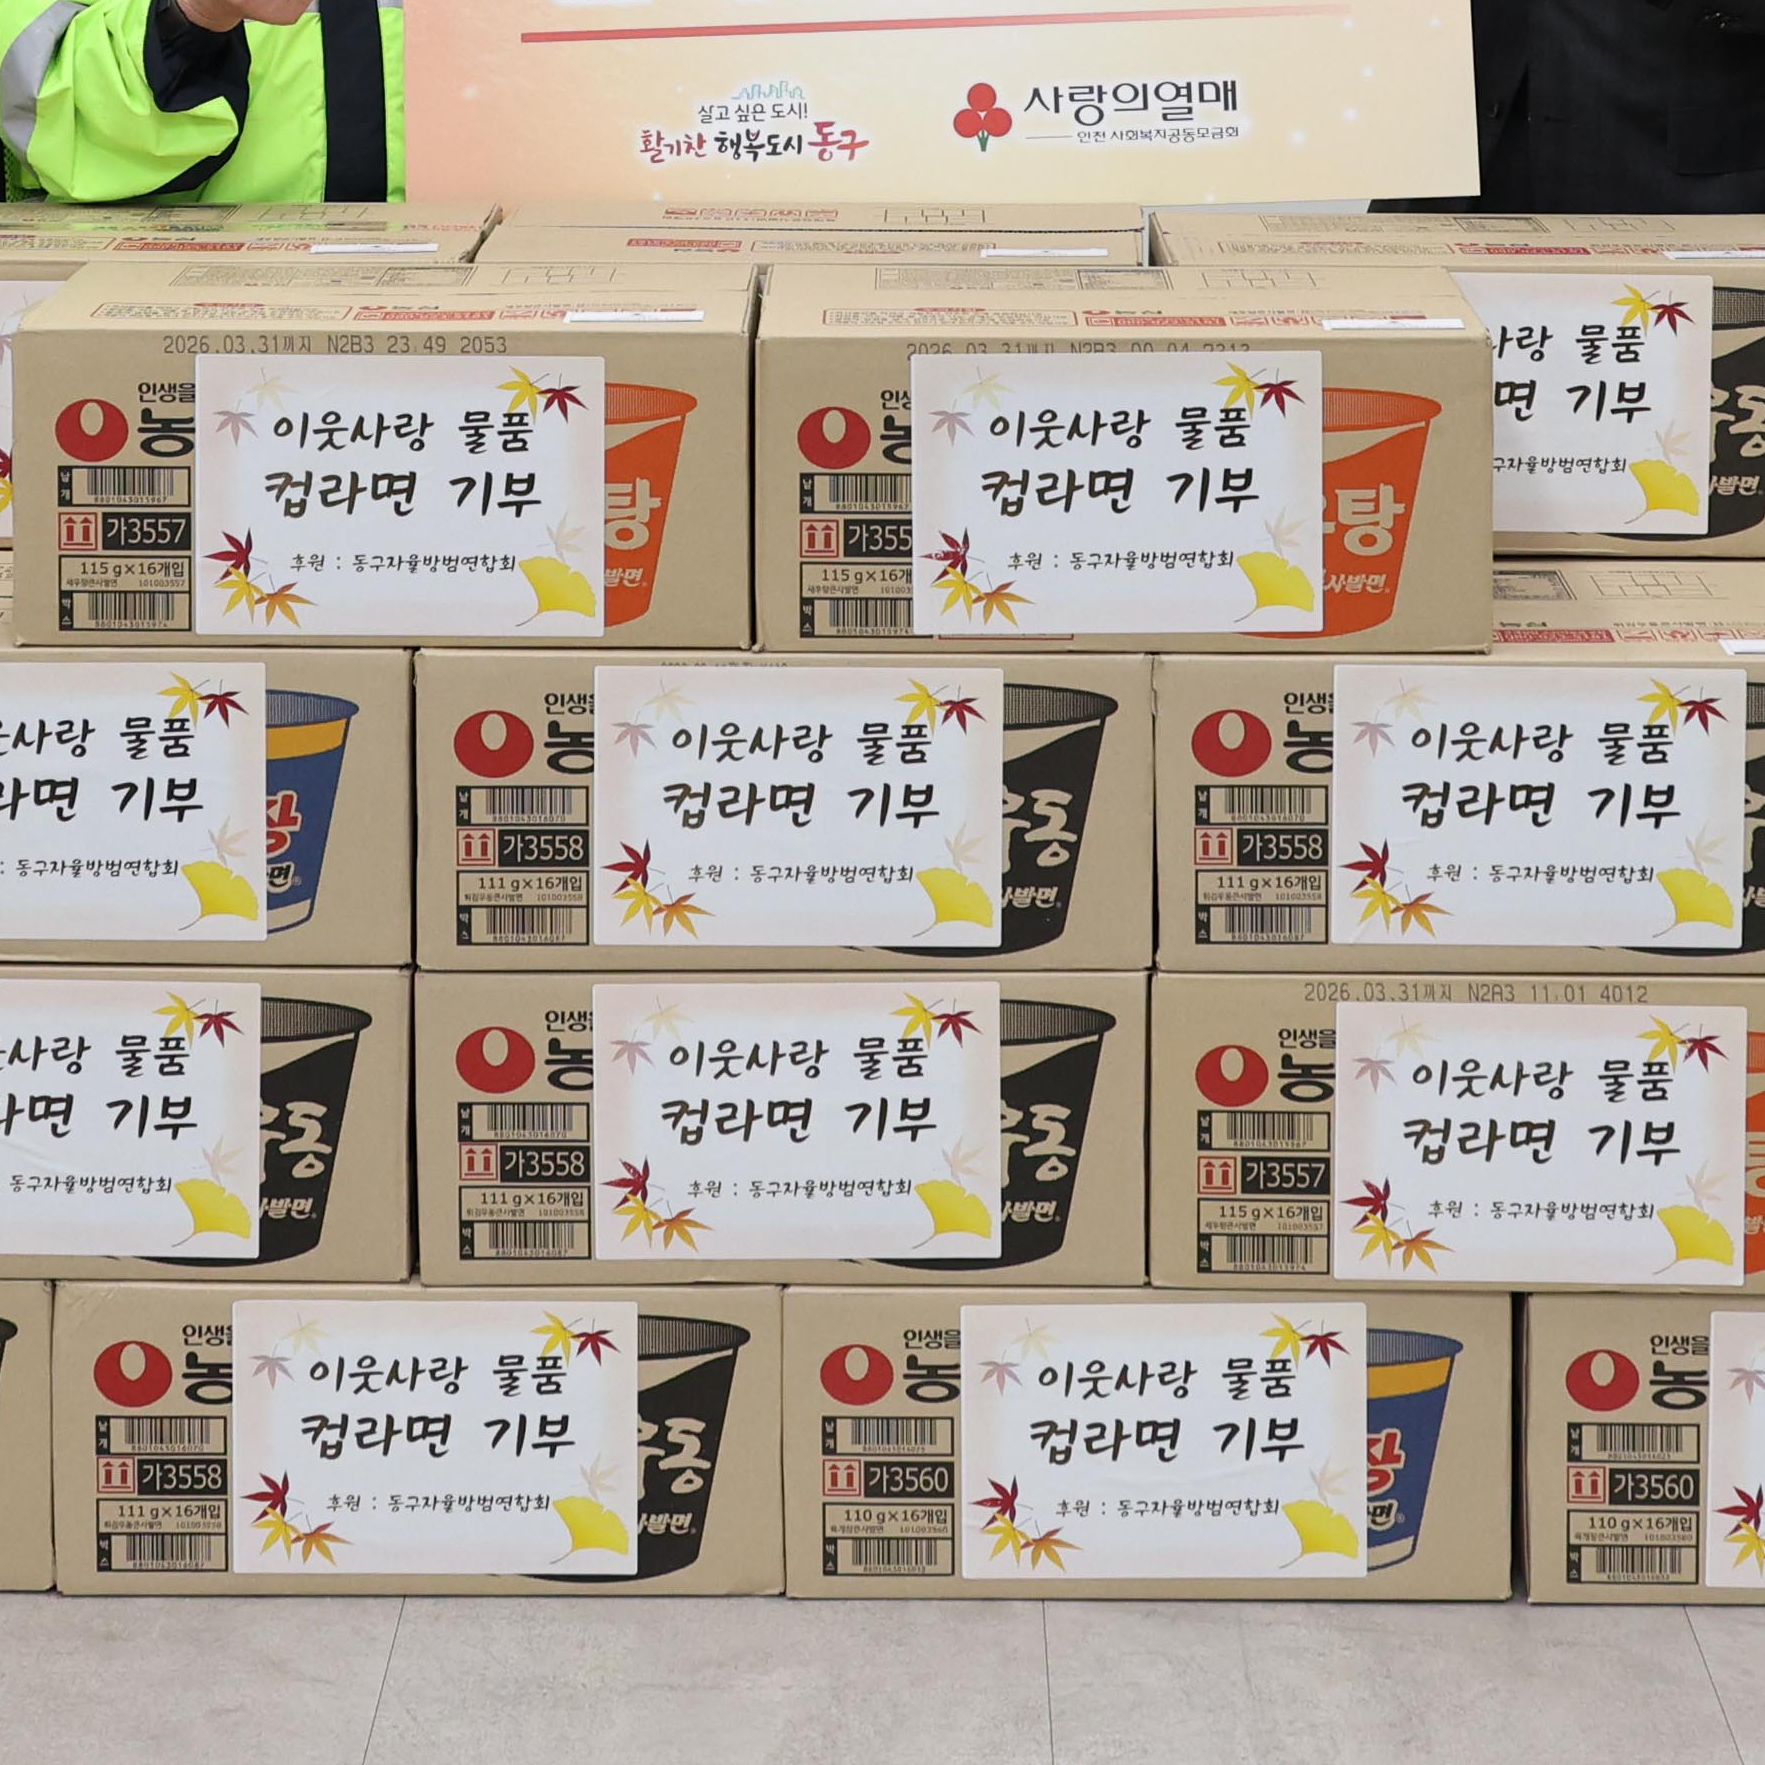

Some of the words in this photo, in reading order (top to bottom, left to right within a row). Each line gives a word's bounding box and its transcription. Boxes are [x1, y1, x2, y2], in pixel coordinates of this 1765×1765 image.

[699, 103, 729, 123] 살고
[735, 102, 765, 123] 싶은
[771, 101, 808, 120] 도시!
[1024, 80, 1238, 126] 사랑의열매
[639, 129, 707, 162] 활기찬
[715, 130, 803, 162] 행복도시
[807, 120, 870, 162] 동구
[1077, 130, 1105, 144] 인천
[1110, 126, 1240, 144] 사회복지공동모금회
[459, 334, 509, 353] 2053
[1576, 324, 1645, 365] 물품
[1566, 380, 1652, 425] 기부
[273, 410, 435, 452] 이웃사랑
[458, 410, 534, 455] 물품
[989, 409, 1151, 450] 이웃사랑
[1175, 406, 1251, 451] 물품
[1493, 456, 1627, 474] 구자율방범연합회
[265, 470, 417, 519] 컵라면
[449, 471, 542, 518] 기부
[981, 467, 1134, 517] 컵라면
[1166, 467, 1260, 514] 기부
[107, 517, 186, 546] 가3557
[290, 553, 325, 572] 후원
[353, 553, 516, 574] 동구자율방범연합회
[1007, 552, 1043, 571] 후원
[1070, 550, 1234, 571] 동구자율방범연합회
[119, 713, 195, 760] 물품
[672, 722, 833, 763] 이웃사랑
[856, 722, 932, 766] 물품
[1411, 721, 1574, 763] 이웃사랑
[1597, 722, 1673, 766] 물품
[111, 777, 204, 823] 기부
[663, 781, 816, 830] 컵라면
[847, 782, 940, 829] 기부
[1402, 781, 1556, 829] 컵라면
[1587, 783, 1681, 830] 기부
[16, 858, 179, 878] 동구자율방범연합회
[503, 834, 584, 862] 가3558
[1242, 833, 1323, 862] 가3558
[688, 864, 723, 883] 후원
[751, 864, 914, 884] 동구자율방범연합회
[1427, 863, 1462, 882] 후원
[1489, 864, 1654, 885] 동구자율방범연합회
[1600, 985, 1648, 1004] 4012
[115, 1034, 190, 1078] 물품
[669, 1039, 829, 1080] 이웃사랑
[853, 1032, 929, 1080] 물품
[1412, 1058, 1574, 1100] 이웃사랑
[1597, 1059, 1673, 1103] 물품
[106, 1094, 198, 1141] 기부
[661, 1097, 813, 1146] 컵라면
[844, 1097, 937, 1142] 기부
[1403, 1118, 1556, 1165] 컵라면
[1588, 1119, 1681, 1167] 기부
[505, 1150, 585, 1178] 가3558
[1246, 1161, 1325, 1189] 가3557
[1428, 1200, 1463, 1219] 후원
[1491, 1201, 1655, 1221] 동구자율방범연합회
[309, 1355, 469, 1395] 이웃사랑
[492, 1352, 568, 1397] 물품
[1038, 1359, 1198, 1400] 이웃사랑
[1221, 1358, 1296, 1401] 물품
[301, 1413, 452, 1460] 컵라면
[483, 1413, 575, 1459] 기부
[1030, 1417, 1181, 1466] 컵라면
[1213, 1417, 1305, 1463] 기부
[142, 1463, 222, 1491] 가3558
[869, 1466, 949, 1494] 가3560
[1614, 1473, 1694, 1501] 가3560
[326, 1494, 361, 1512] 후원
[388, 1494, 550, 1513] 동구자율방범연합회
[1056, 1499, 1090, 1518] 후원
[1119, 1498, 1280, 1518] 동구자율방범연합회
